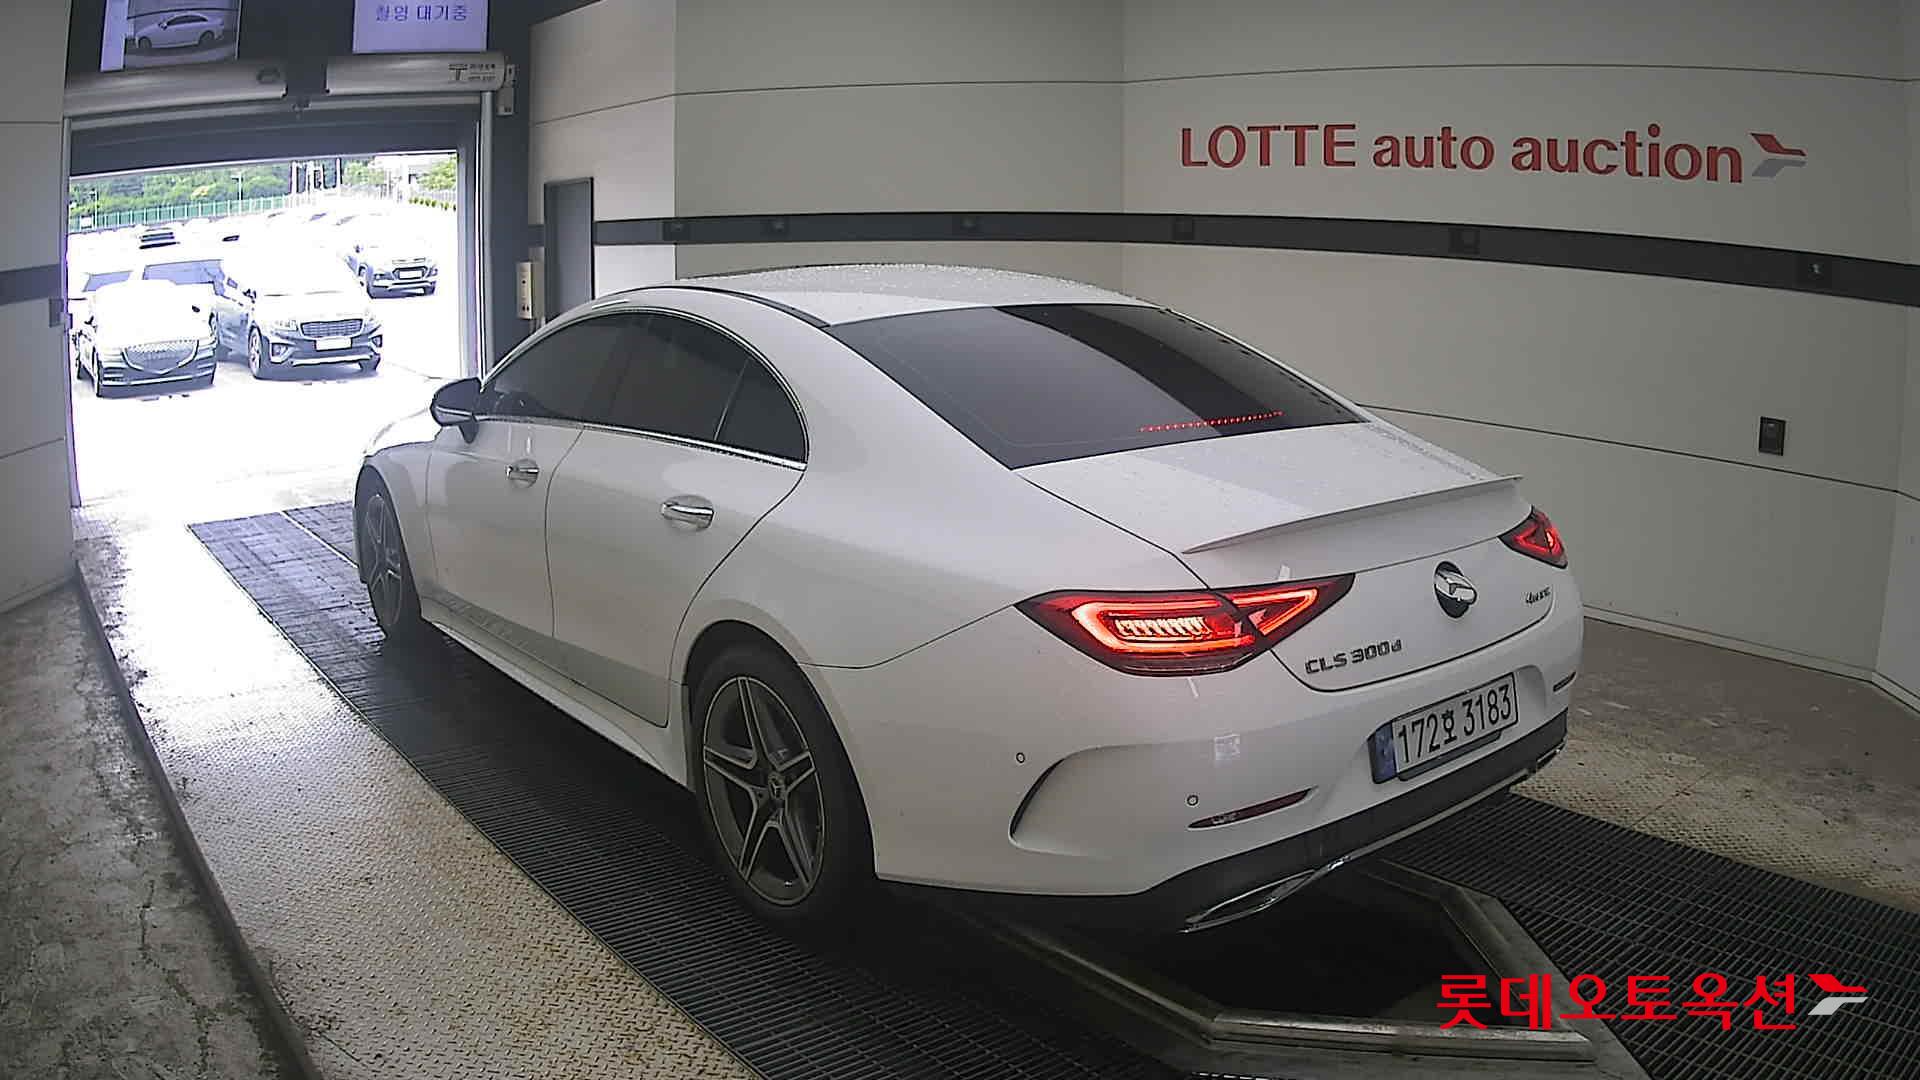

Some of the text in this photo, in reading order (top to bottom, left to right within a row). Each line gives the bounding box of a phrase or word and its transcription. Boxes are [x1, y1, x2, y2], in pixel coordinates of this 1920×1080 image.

[416, 5, 468, 22] 대기중
[1181, 123, 1742, 183] LOTTE auto auction
[1305, 653, 1348, 674] CLS
[1398, 684, 1512, 763] 172호 3183
